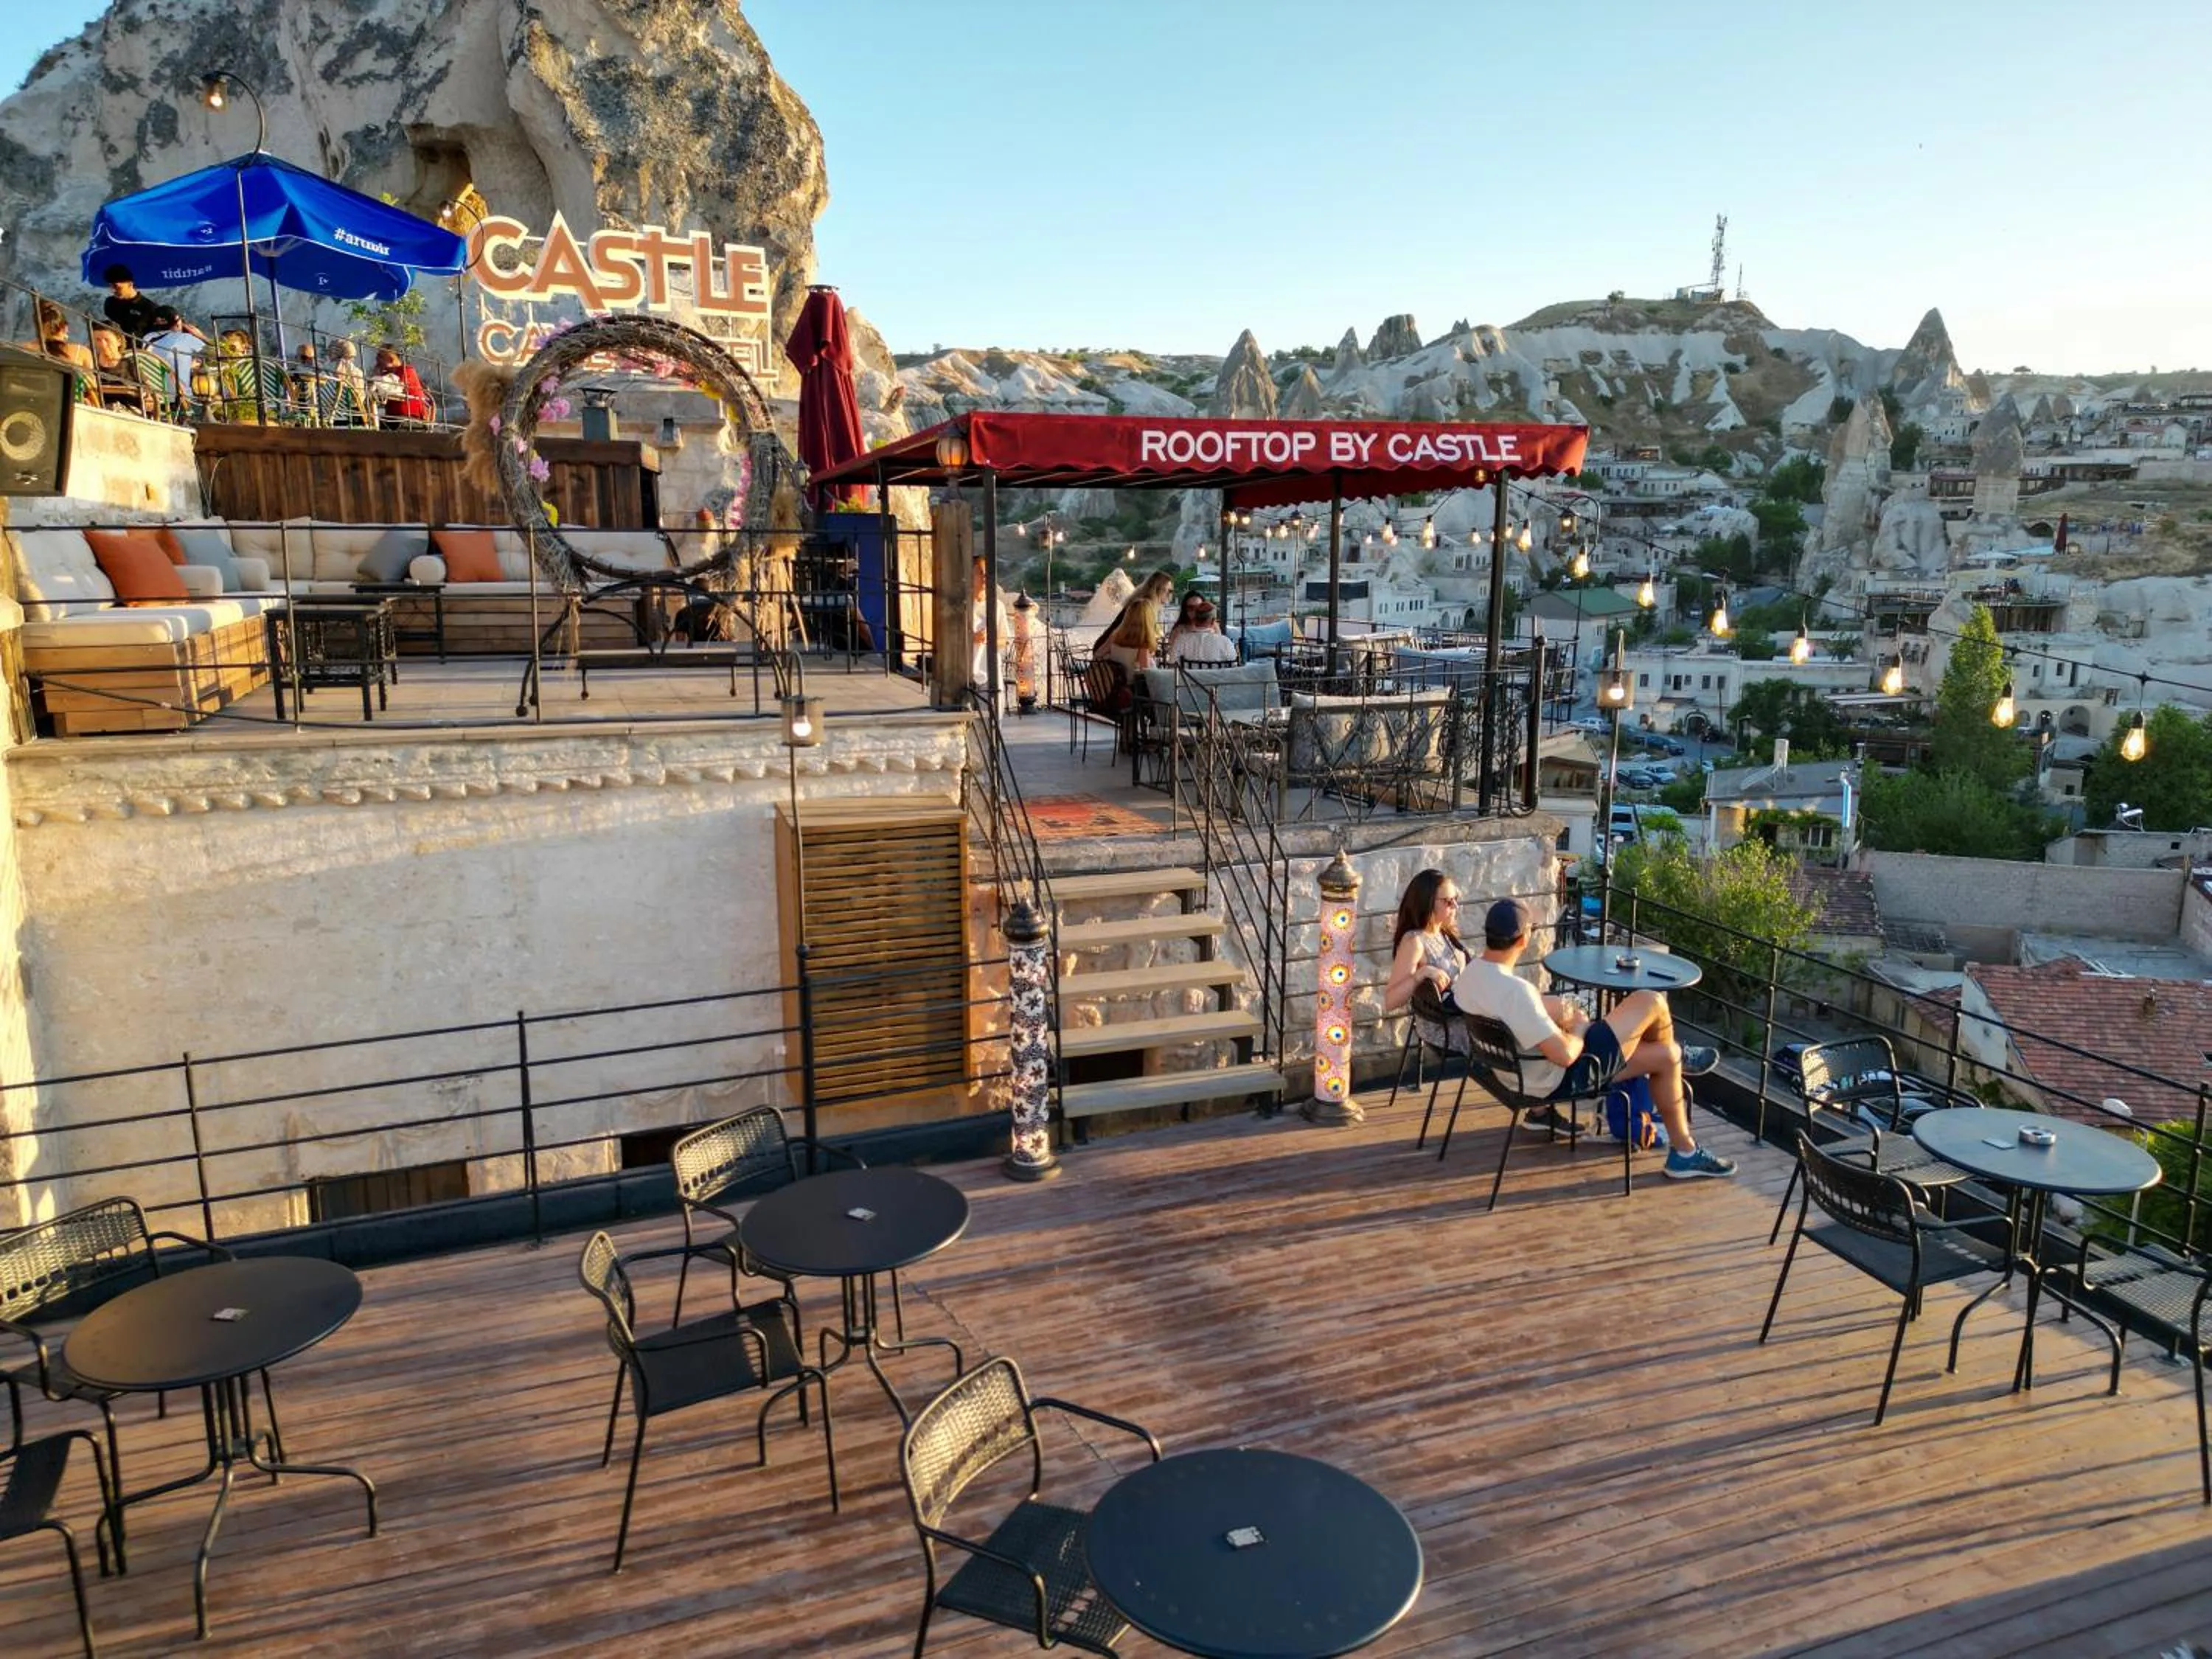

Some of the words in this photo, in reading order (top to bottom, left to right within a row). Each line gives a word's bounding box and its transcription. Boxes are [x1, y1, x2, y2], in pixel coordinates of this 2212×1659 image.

[467, 209, 771, 319] CASTLE
[1141, 430, 1316, 463] ROOFTOP
[1330, 431, 1378, 462] BY
[1388, 433, 1522, 462] CASTLE
